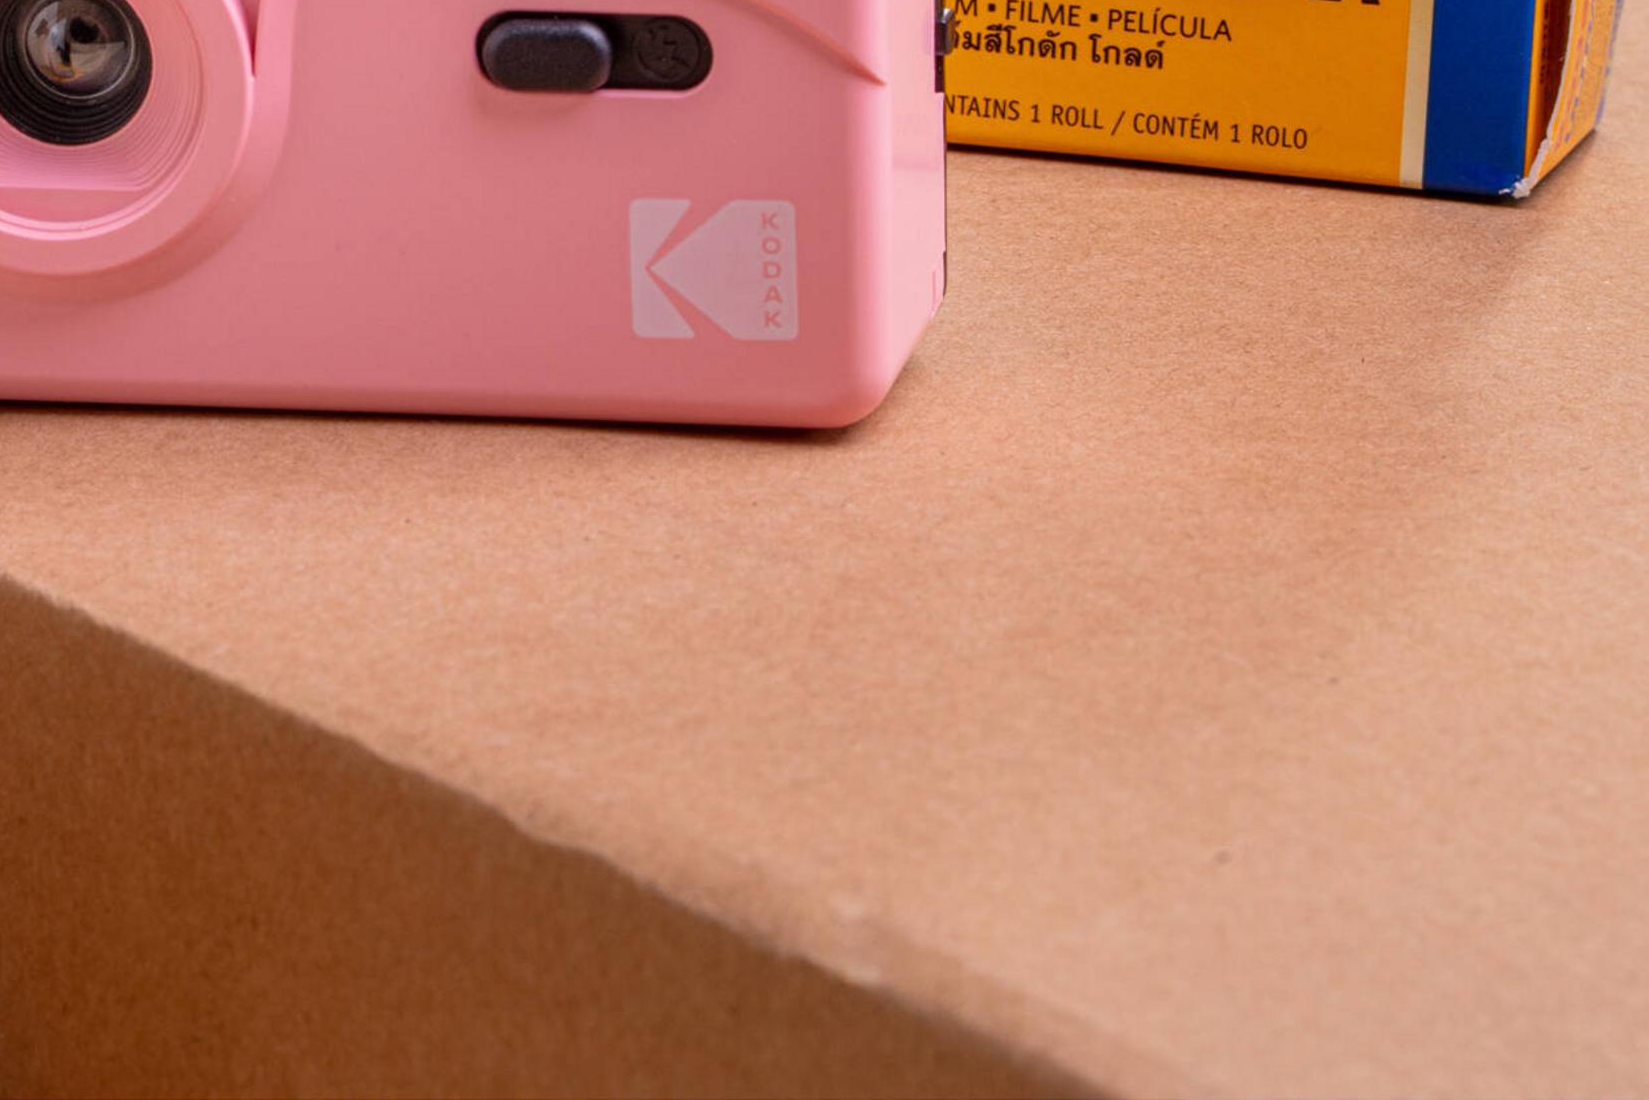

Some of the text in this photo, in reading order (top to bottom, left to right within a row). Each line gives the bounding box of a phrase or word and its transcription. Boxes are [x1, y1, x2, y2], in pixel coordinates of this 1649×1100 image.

[1107, 7, 1232, 43] PELÍCULA
[944, 93, 1021, 122] NTAINS
[1030, 103, 1040, 123] 1
[1051, 103, 1104, 130] ROLL
[1132, 111, 1219, 142] CONTÉM
[1230, 123, 1241, 143] 1
[1251, 124, 1308, 150] ROLO
[760, 212, 783, 329] KODAK
